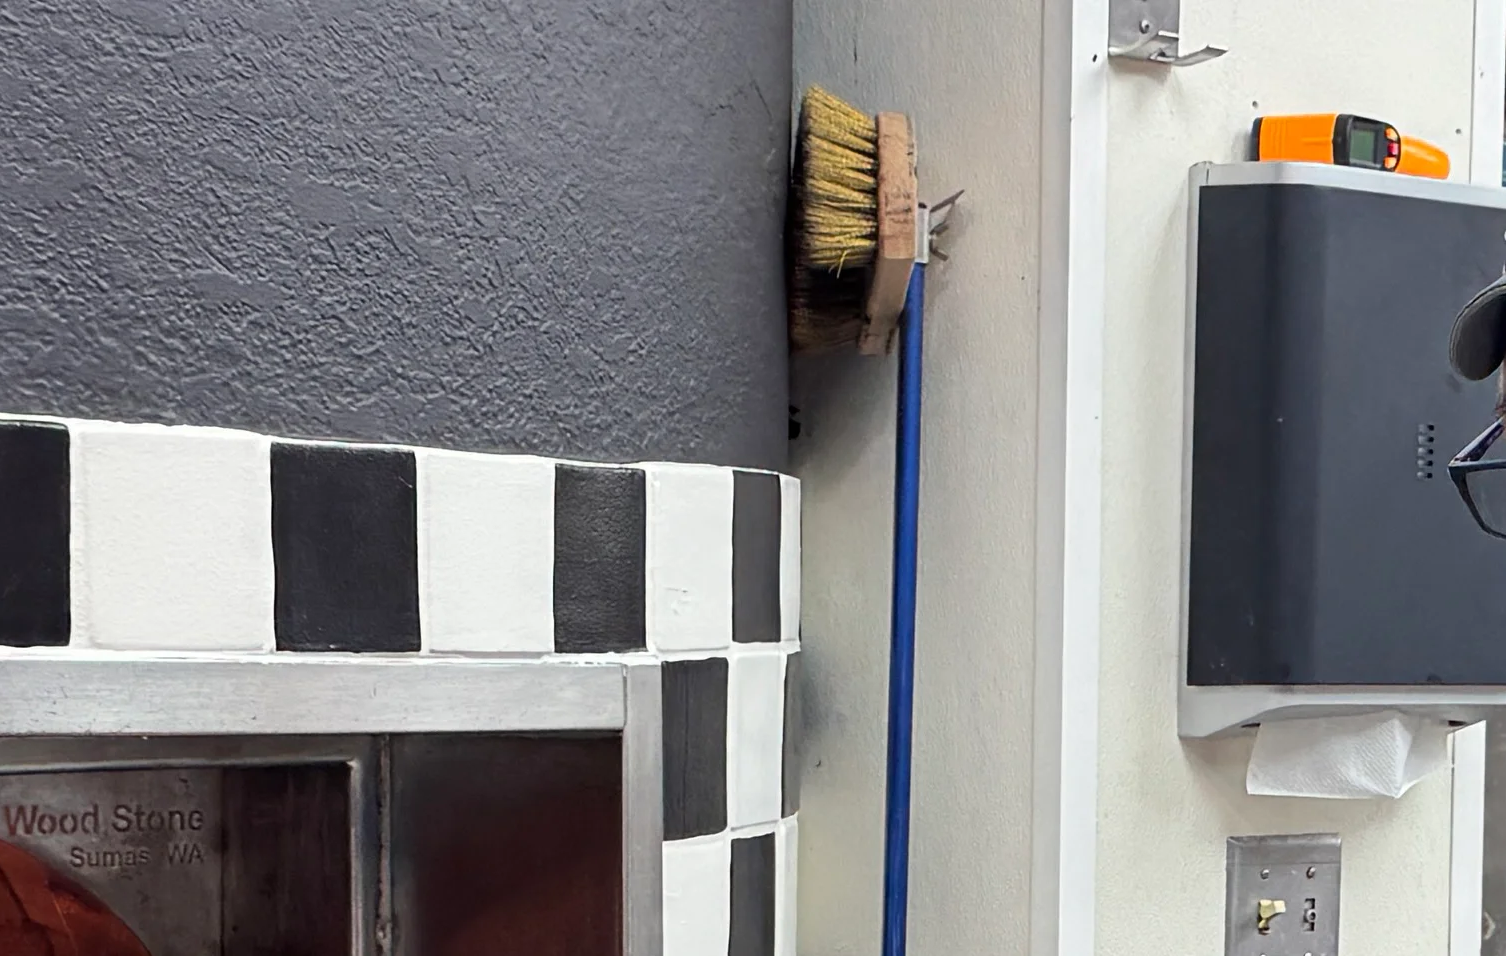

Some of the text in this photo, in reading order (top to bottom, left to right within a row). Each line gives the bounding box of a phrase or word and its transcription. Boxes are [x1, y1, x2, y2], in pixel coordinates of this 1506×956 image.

[3, 803, 204, 837] Wood Stone
[167, 844, 204, 865] WA
